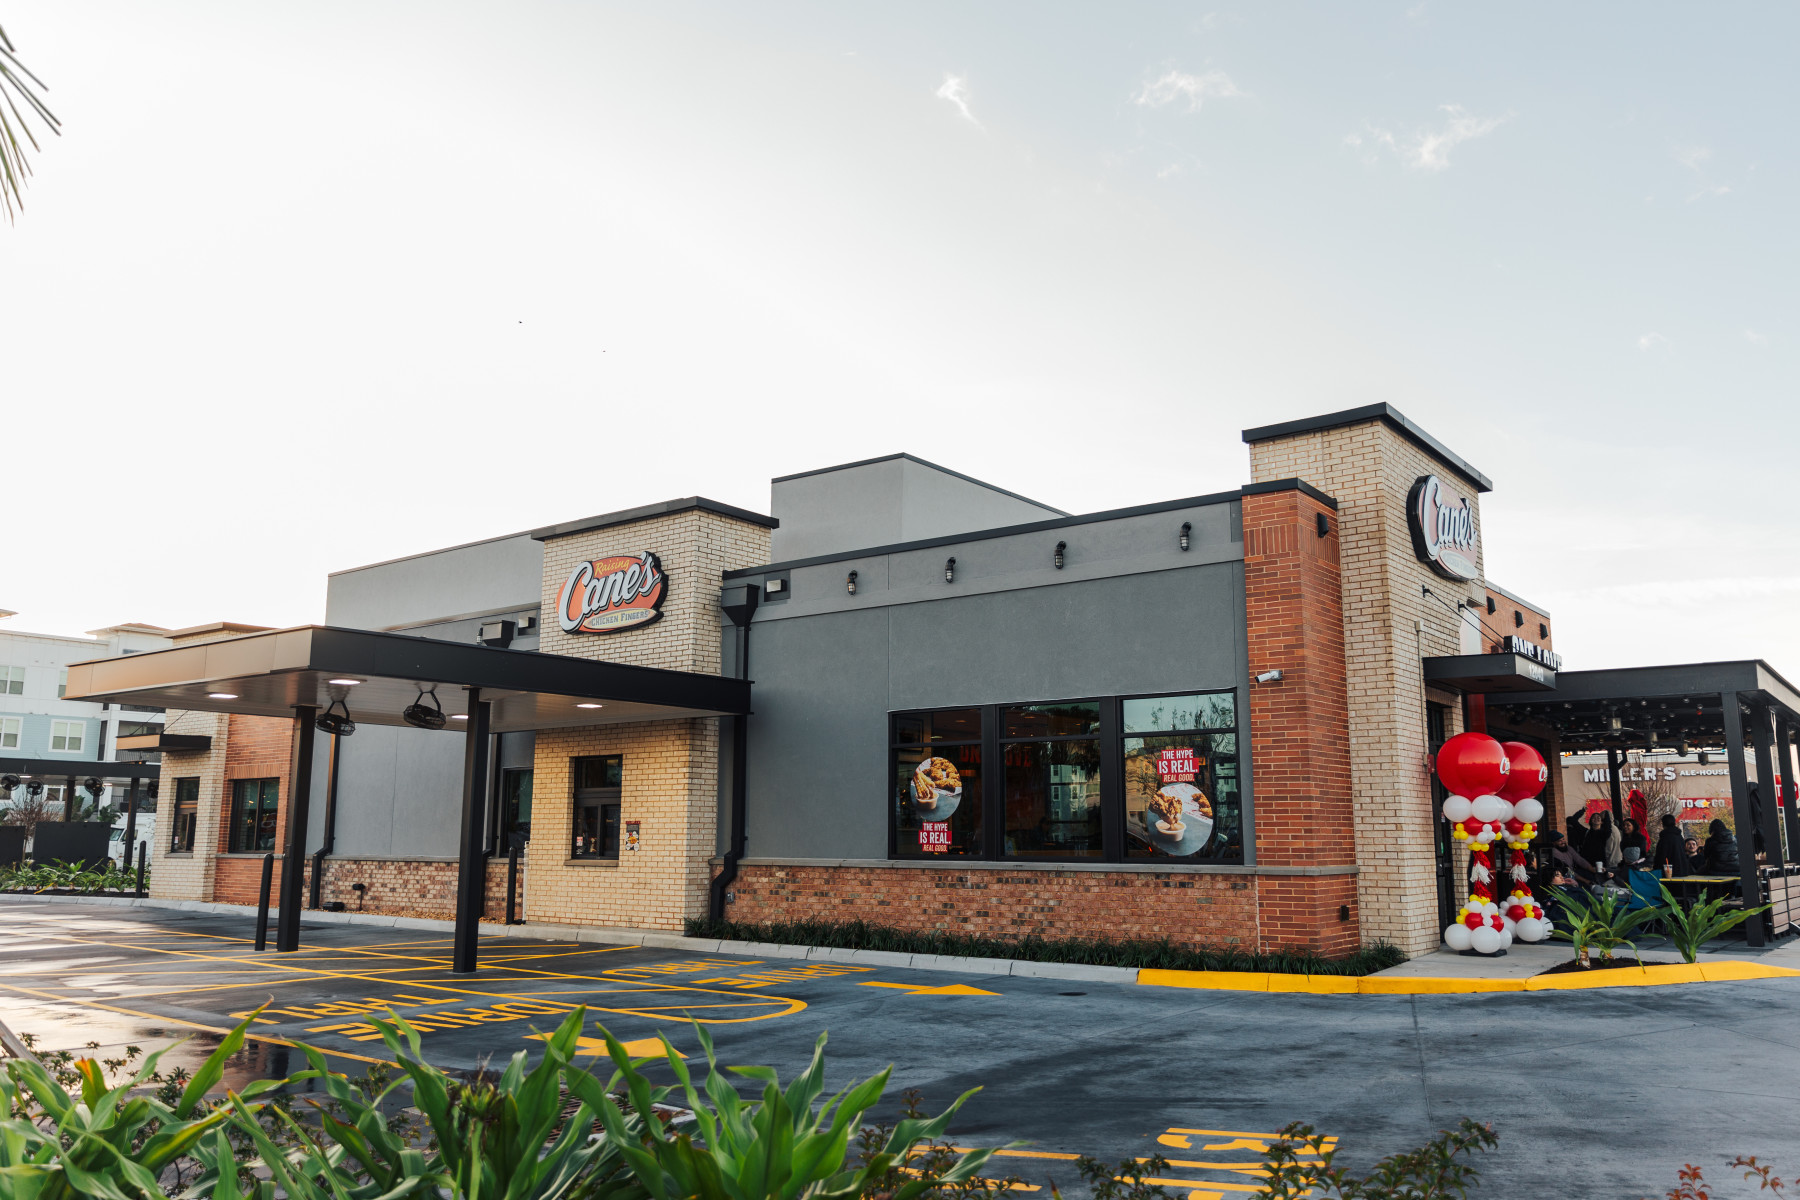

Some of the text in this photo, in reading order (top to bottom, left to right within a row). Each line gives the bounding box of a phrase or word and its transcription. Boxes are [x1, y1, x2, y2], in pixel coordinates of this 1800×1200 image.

[594, 559, 630, 577] Raising
[1162, 749, 1193, 760] THE HYPE
[1158, 759, 1198, 774] IS REAL.
[1163, 774, 1177, 782] REAL
[1681, 799, 1694, 808] TO
[923, 822, 948, 831] THE HYPE
[920, 831, 951, 844] IS REAL.
